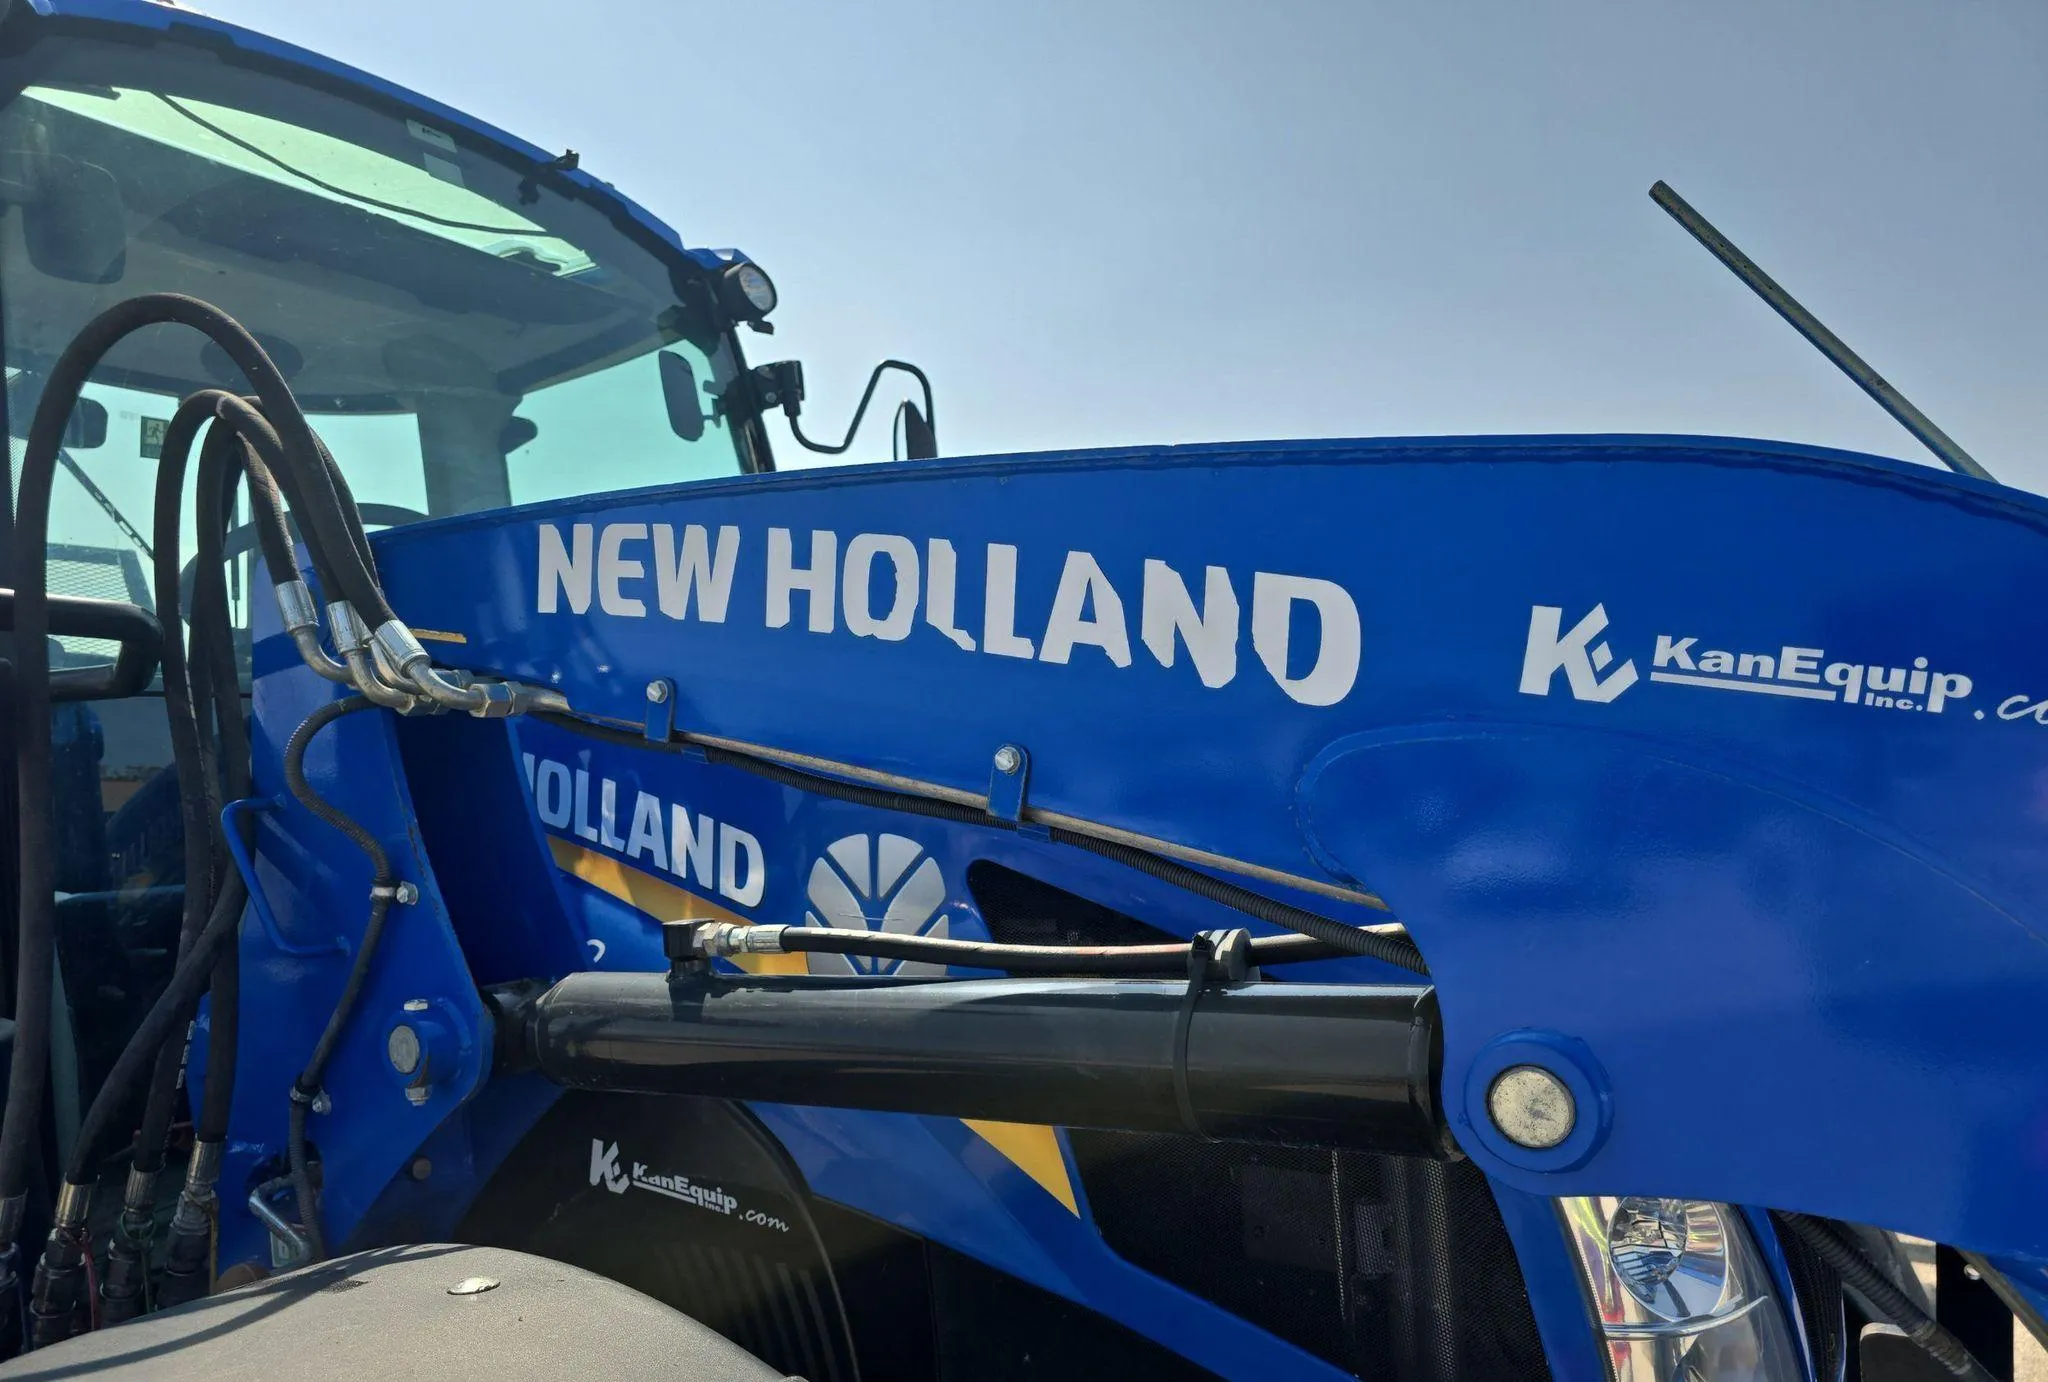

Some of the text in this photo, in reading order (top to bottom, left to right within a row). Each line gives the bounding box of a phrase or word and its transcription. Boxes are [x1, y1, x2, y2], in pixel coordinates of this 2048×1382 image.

[537, 523, 1361, 707] NEW HOLLAND
[522, 752, 766, 908] OLLAND
